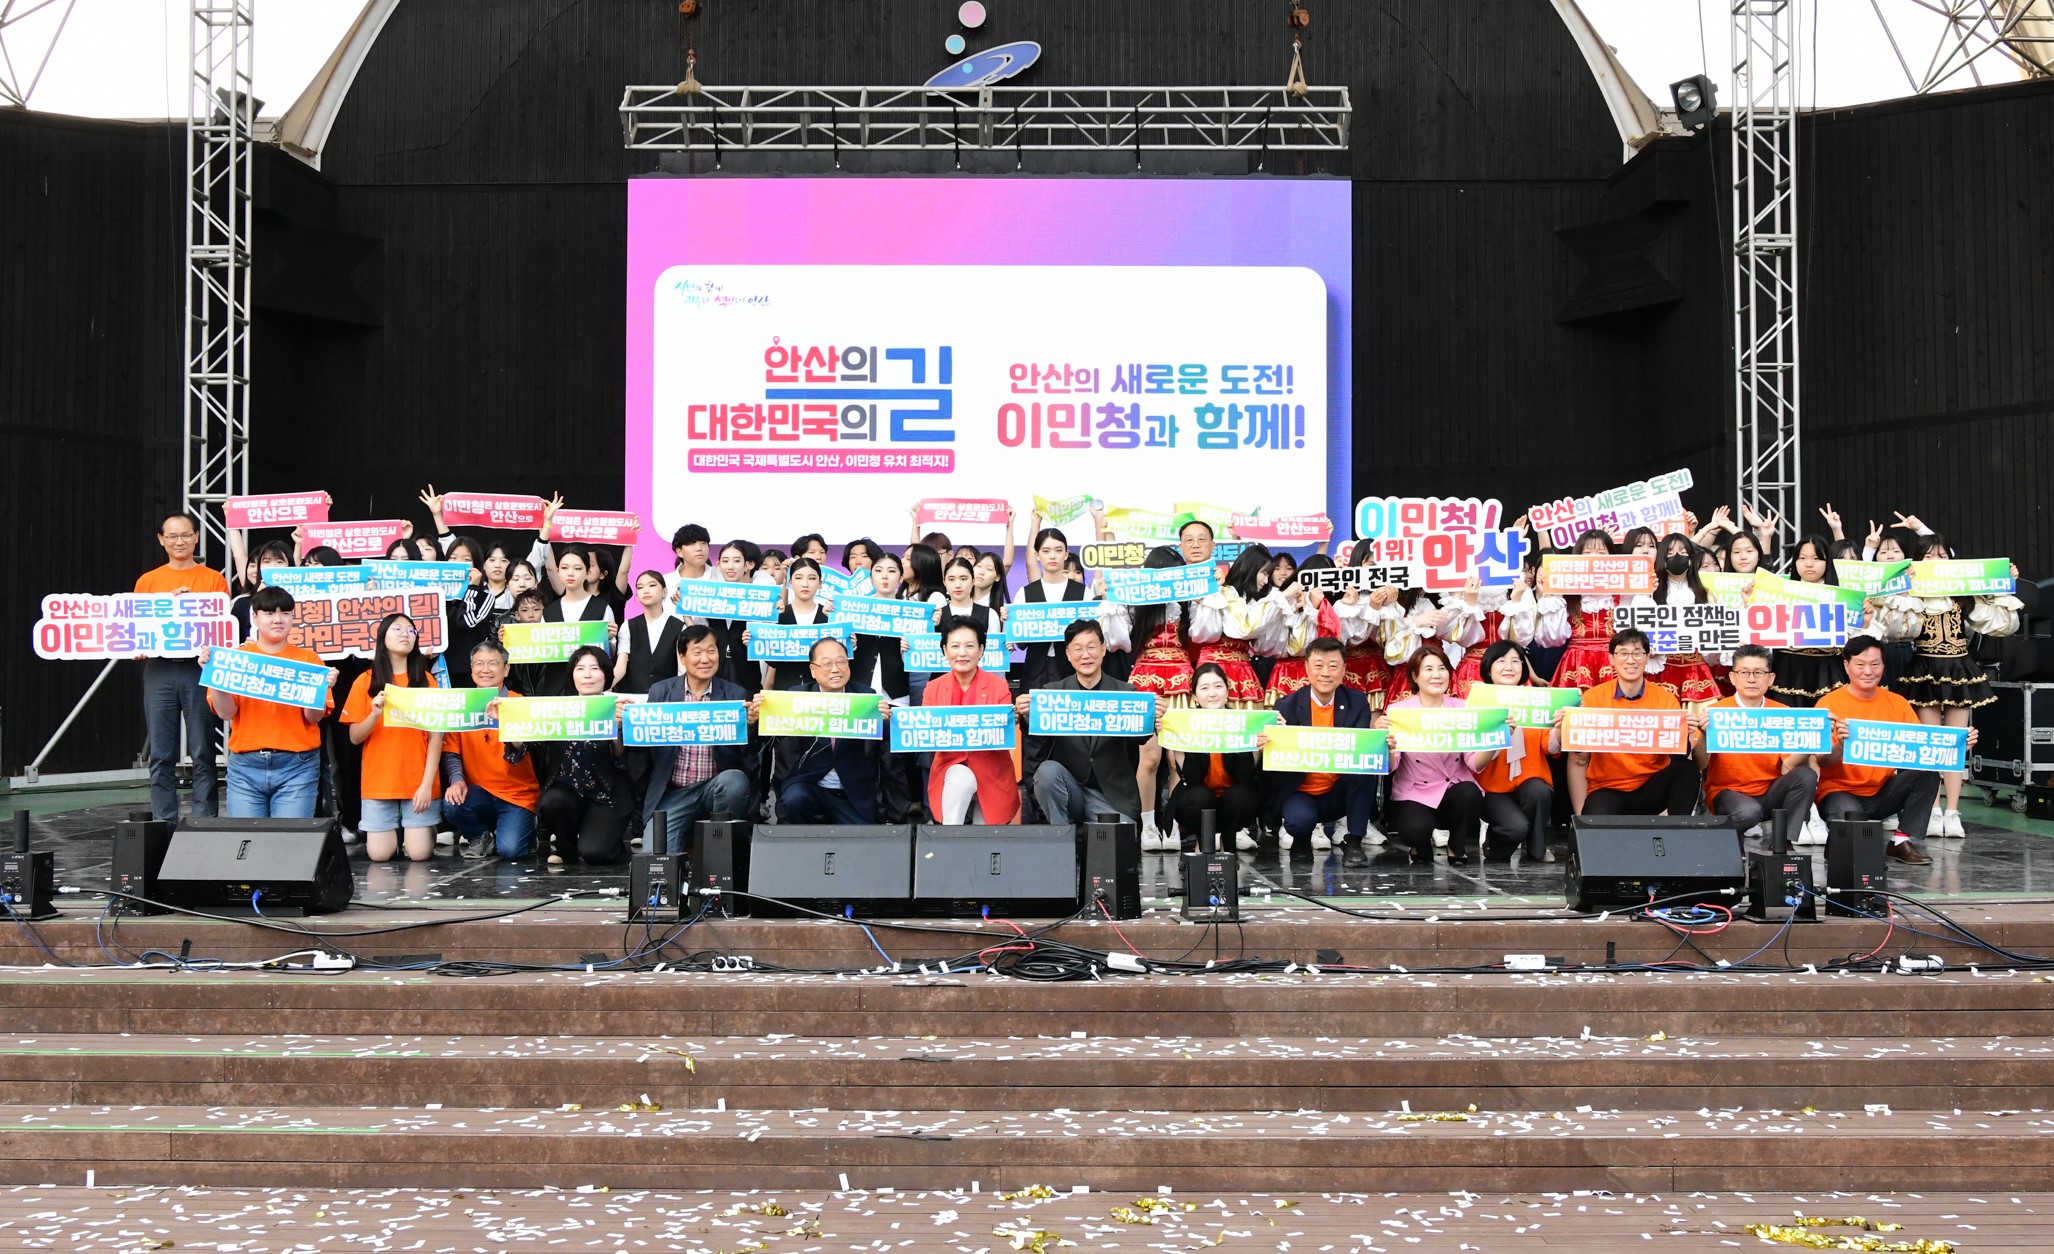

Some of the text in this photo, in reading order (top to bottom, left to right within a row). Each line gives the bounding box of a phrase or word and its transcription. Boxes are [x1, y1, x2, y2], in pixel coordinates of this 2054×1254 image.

[1009, 363, 1293, 395] 안산의 새로운 도전!
[764, 346, 956, 442] 안산의 길
[687, 403, 878, 441] 대한민국의
[997, 402, 1305, 449] 이민청과 함께!
[693, 454, 949, 470] 대한민국 국제특별도시 안산, 이민청 유치 최적지!
[444, 500, 542, 515] 이민청은 상호문화도시
[1531, 471, 1690, 530] 안산의 새로운 도전!
[247, 507, 308, 523] 안산으로
[490, 511, 534, 526] 안산으로
[1360, 502, 1498, 539] 이민청!
[1641, 501, 1681, 524] 함께!
[344, 526, 397, 538] 상호문화도시
[560, 526, 617, 542] 안산으로
[1276, 522, 1319, 536] 안산으로
[1422, 531, 1527, 589] 안산
[1550, 560, 1648, 572] 이민청! 안산의 길!
[272, 571, 360, 584] 안산의 새로운 도전!
[408, 570, 440, 581] 새로운
[442, 569, 466, 582] 도전!
[1110, 570, 1151, 586] 안산의
[1152, 567, 1185, 582] 새로운
[1301, 567, 1410, 592] 외국인 전국
[1934, 563, 1985, 578] 이민청!
[1113, 578, 1209, 600] 이민청과 함께!
[1550, 573, 1648, 590] 대한민국의 길!
[1967, 577, 2011, 592] 합니다!
[688, 584, 771, 601] 안산의 새로운 도전!
[49, 598, 224, 619] 안산의 새로운 도전!
[337, 592, 439, 622] 안산의 길!
[681, 596, 773, 618] 이민청과 함께!
[841, 600, 925, 619] 안산의 새로운 도전!
[1016, 607, 1078, 621] 안산의 새로운
[835, 610, 929, 636] 이민청과 함께!
[1615, 606, 1678, 628] 외국인
[1683, 604, 1740, 628] 정책의
[1747, 603, 1845, 647] 안산!
[41, 620, 233, 653] 이민청과 함께!
[530, 625, 581, 643] 이민청!
[757, 627, 787, 639] 안산의
[788, 627, 819, 639] 새로운
[1698, 629, 1741, 651] 만든
[508, 643, 560, 659] 안산시가
[754, 639, 810, 657] 이민청과
[213, 650, 259, 675] 안산의
[259, 663, 297, 682] 새로운
[211, 669, 318, 704] 이민청과 함께!
[415, 692, 466, 711] 이민청!
[791, 696, 850, 715] 이민청!
[1036, 693, 1148, 713] 안산의 새로운 도전!
[1495, 689, 1552, 707] 이민청!
[389, 708, 444, 728] 안산시가
[531, 700, 586, 719] 이민청!
[629, 707, 740, 726] 안산의 새로운 도전!
[504, 719, 614, 738] 안산시가 합니다!
[765, 715, 877, 735] 안산시가 합니다!
[897, 711, 1008, 730] 안산의 새로운 도전!
[1039, 712, 1144, 732] 이민청과 함께!
[1189, 713, 1246, 733] 이민청!
[1421, 711, 1478, 730] 이민청!
[1569, 713, 1614, 729] 이민청!
[1618, 714, 1660, 730] 안산의
[1662, 715, 1681, 729] 길!
[1713, 711, 1825, 730] 안산의 새로운 도전!
[633, 724, 737, 743] 이민청과 함께!
[901, 728, 1004, 748] 이민청과 함께!
[1163, 730, 1222, 749] 안산시가
[1297, 731, 1356, 751] 이민청!
[1396, 731, 1506, 749] 안산시가 합니다!
[1568, 729, 1680, 749] 대한민국의 길!
[1717, 731, 1821, 749] 이민청과 함께!
[1857, 726, 1957, 746] 안산의 새로운 도전!
[1270, 751, 1384, 770] 안산시가 합니다!
[1850, 741, 1958, 766] 이민청과 함께!
